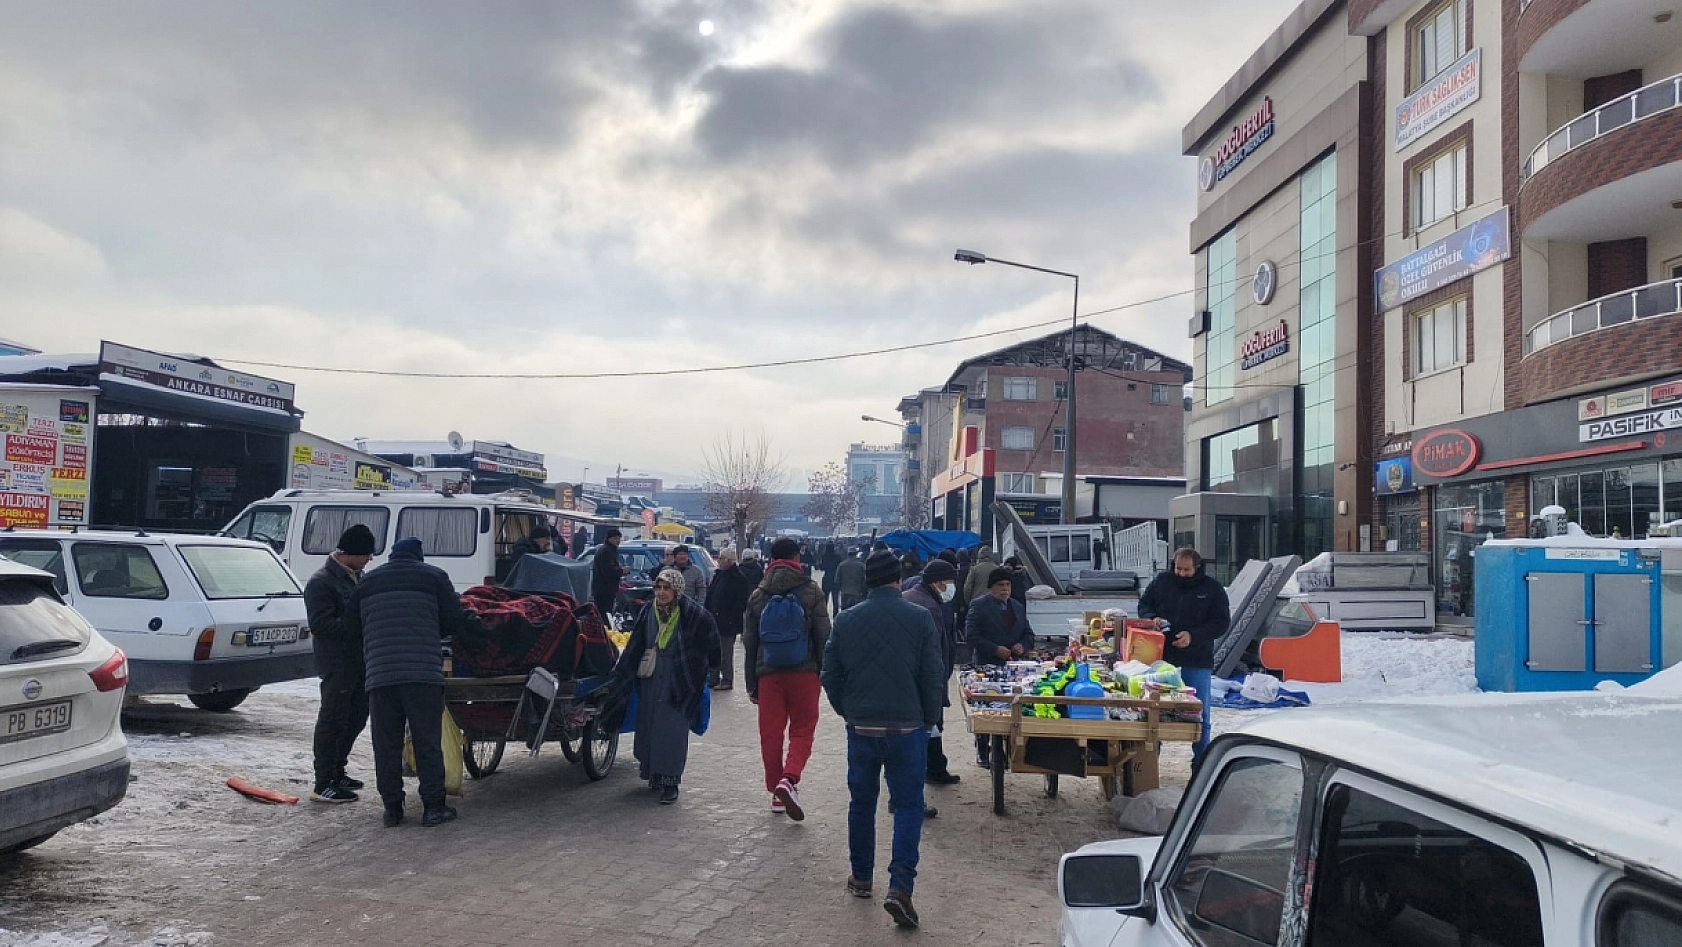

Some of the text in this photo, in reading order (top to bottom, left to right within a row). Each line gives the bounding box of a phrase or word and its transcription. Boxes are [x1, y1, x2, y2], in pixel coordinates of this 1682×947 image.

[1412, 94, 1431, 117] TÜRK
[1401, 241, 1447, 274] BATTALGAZİ
[1401, 269, 1421, 287] ÖZEL
[1421, 249, 1463, 278] GÜVENLİK
[1401, 278, 1428, 299] OKULU
[168, 377, 210, 396] ANKARA
[213, 387, 245, 402] ESNAF
[0, 493, 47, 509] YILDIRIM
[8, 705, 67, 733] PB 6319
